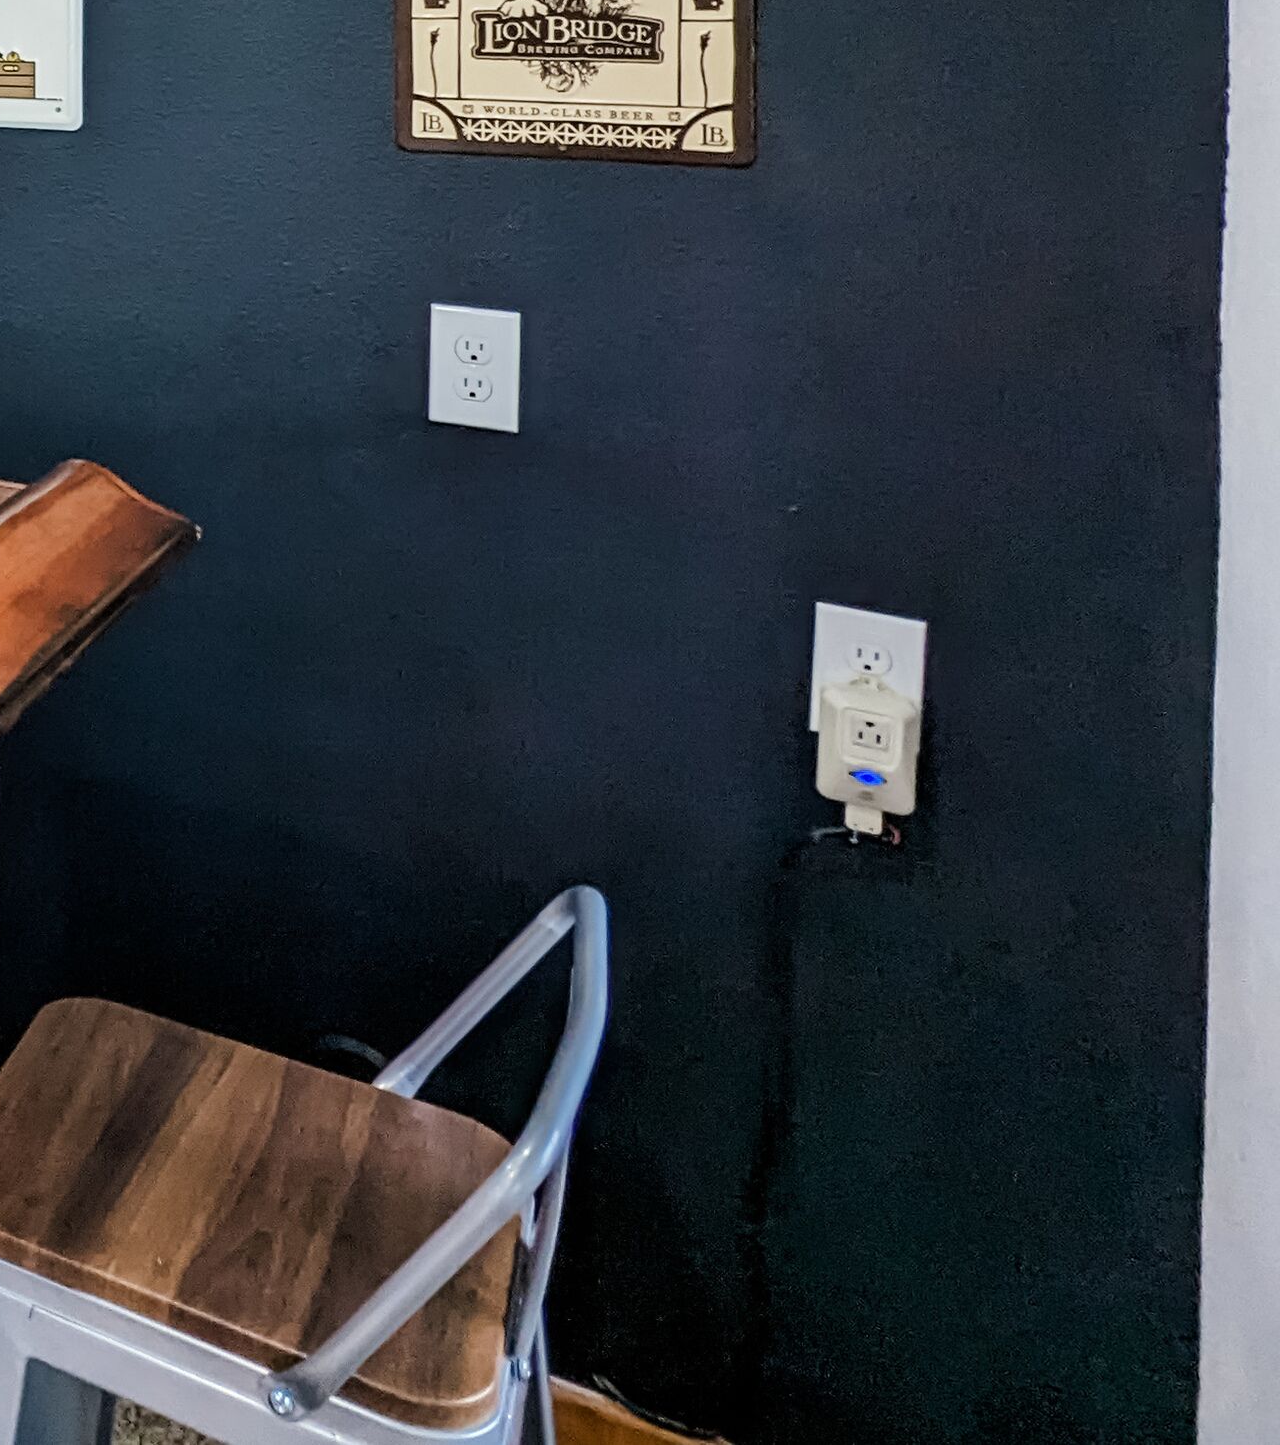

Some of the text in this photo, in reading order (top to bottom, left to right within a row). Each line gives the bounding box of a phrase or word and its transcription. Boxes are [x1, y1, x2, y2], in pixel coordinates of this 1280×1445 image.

[480, 15, 652, 53] LION BRIDGE
[517, 44, 651, 56] BREWING COMPANY
[421, 112, 444, 133] LB
[483, 105, 654, 121] WORLD-CLASS BEER
[701, 123, 728, 147] LB
